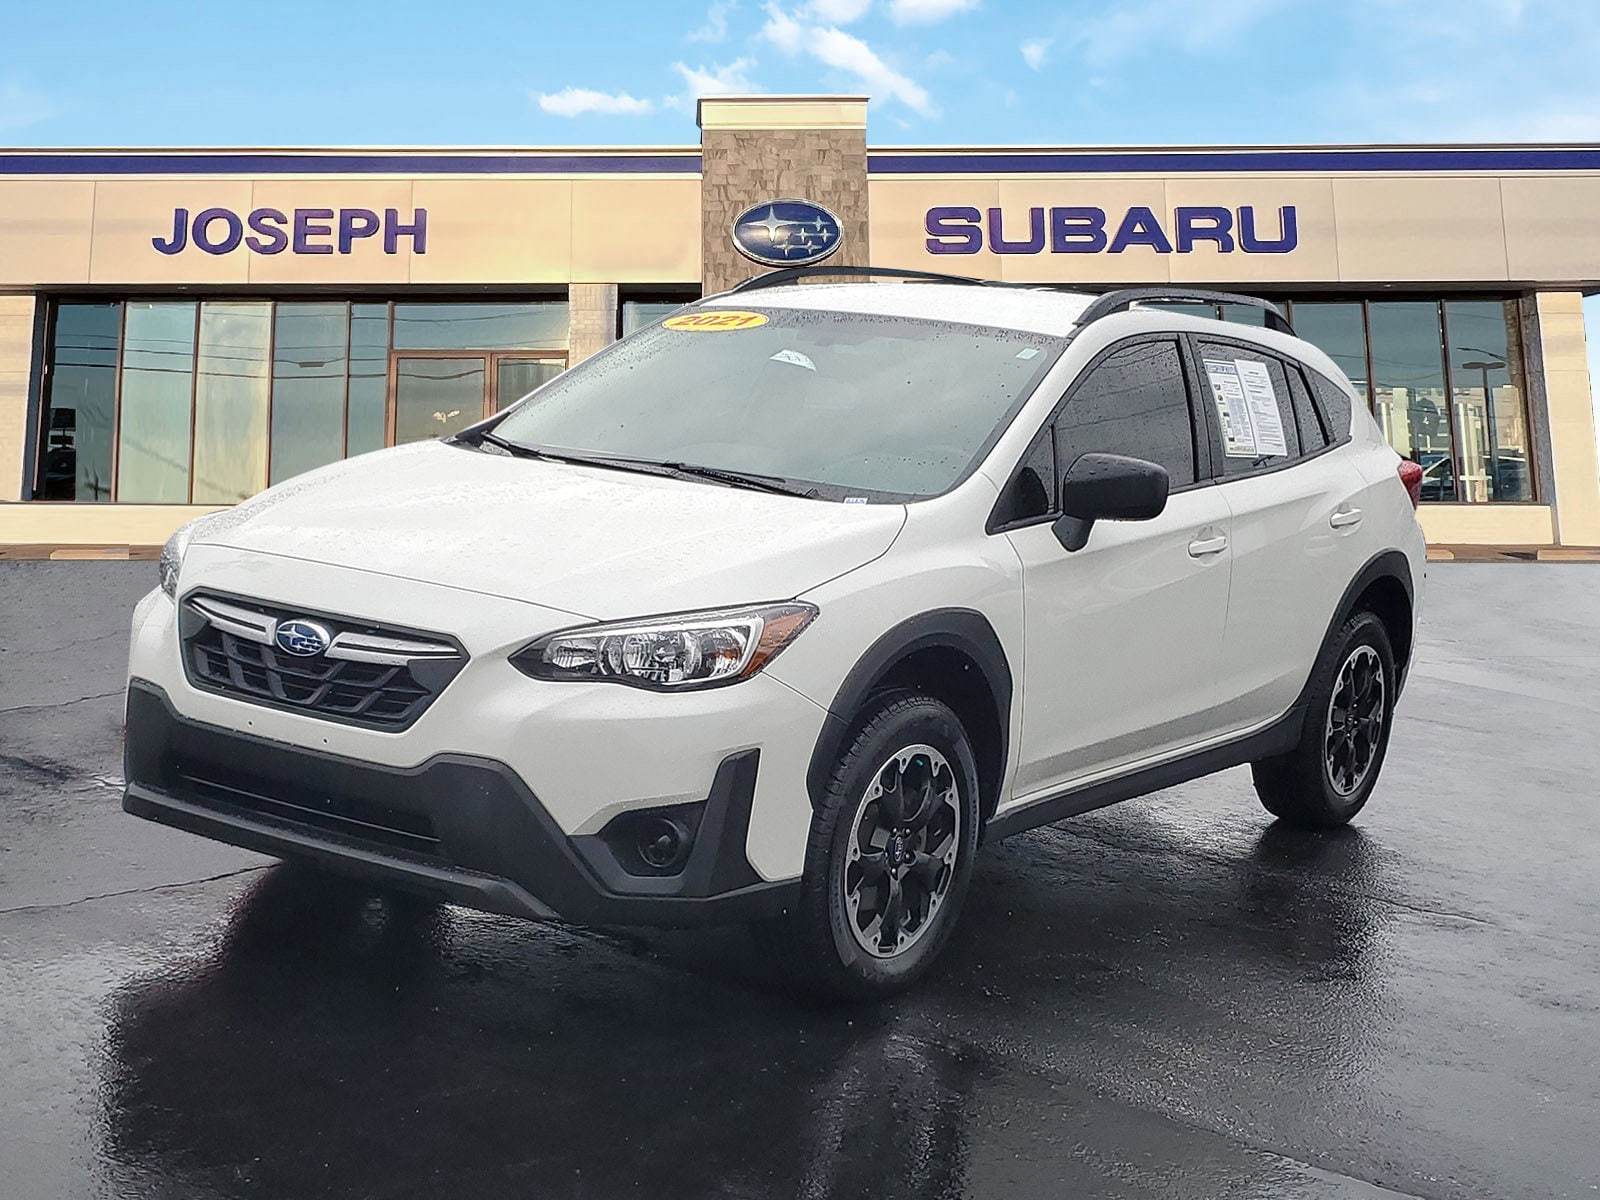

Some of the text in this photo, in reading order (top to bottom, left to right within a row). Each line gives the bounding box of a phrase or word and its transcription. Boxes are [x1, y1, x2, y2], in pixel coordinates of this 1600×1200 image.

[152, 208, 427, 254] JOSEPH
[925, 206, 1298, 254] SUBARU
[670, 315, 758, 326] 2021
